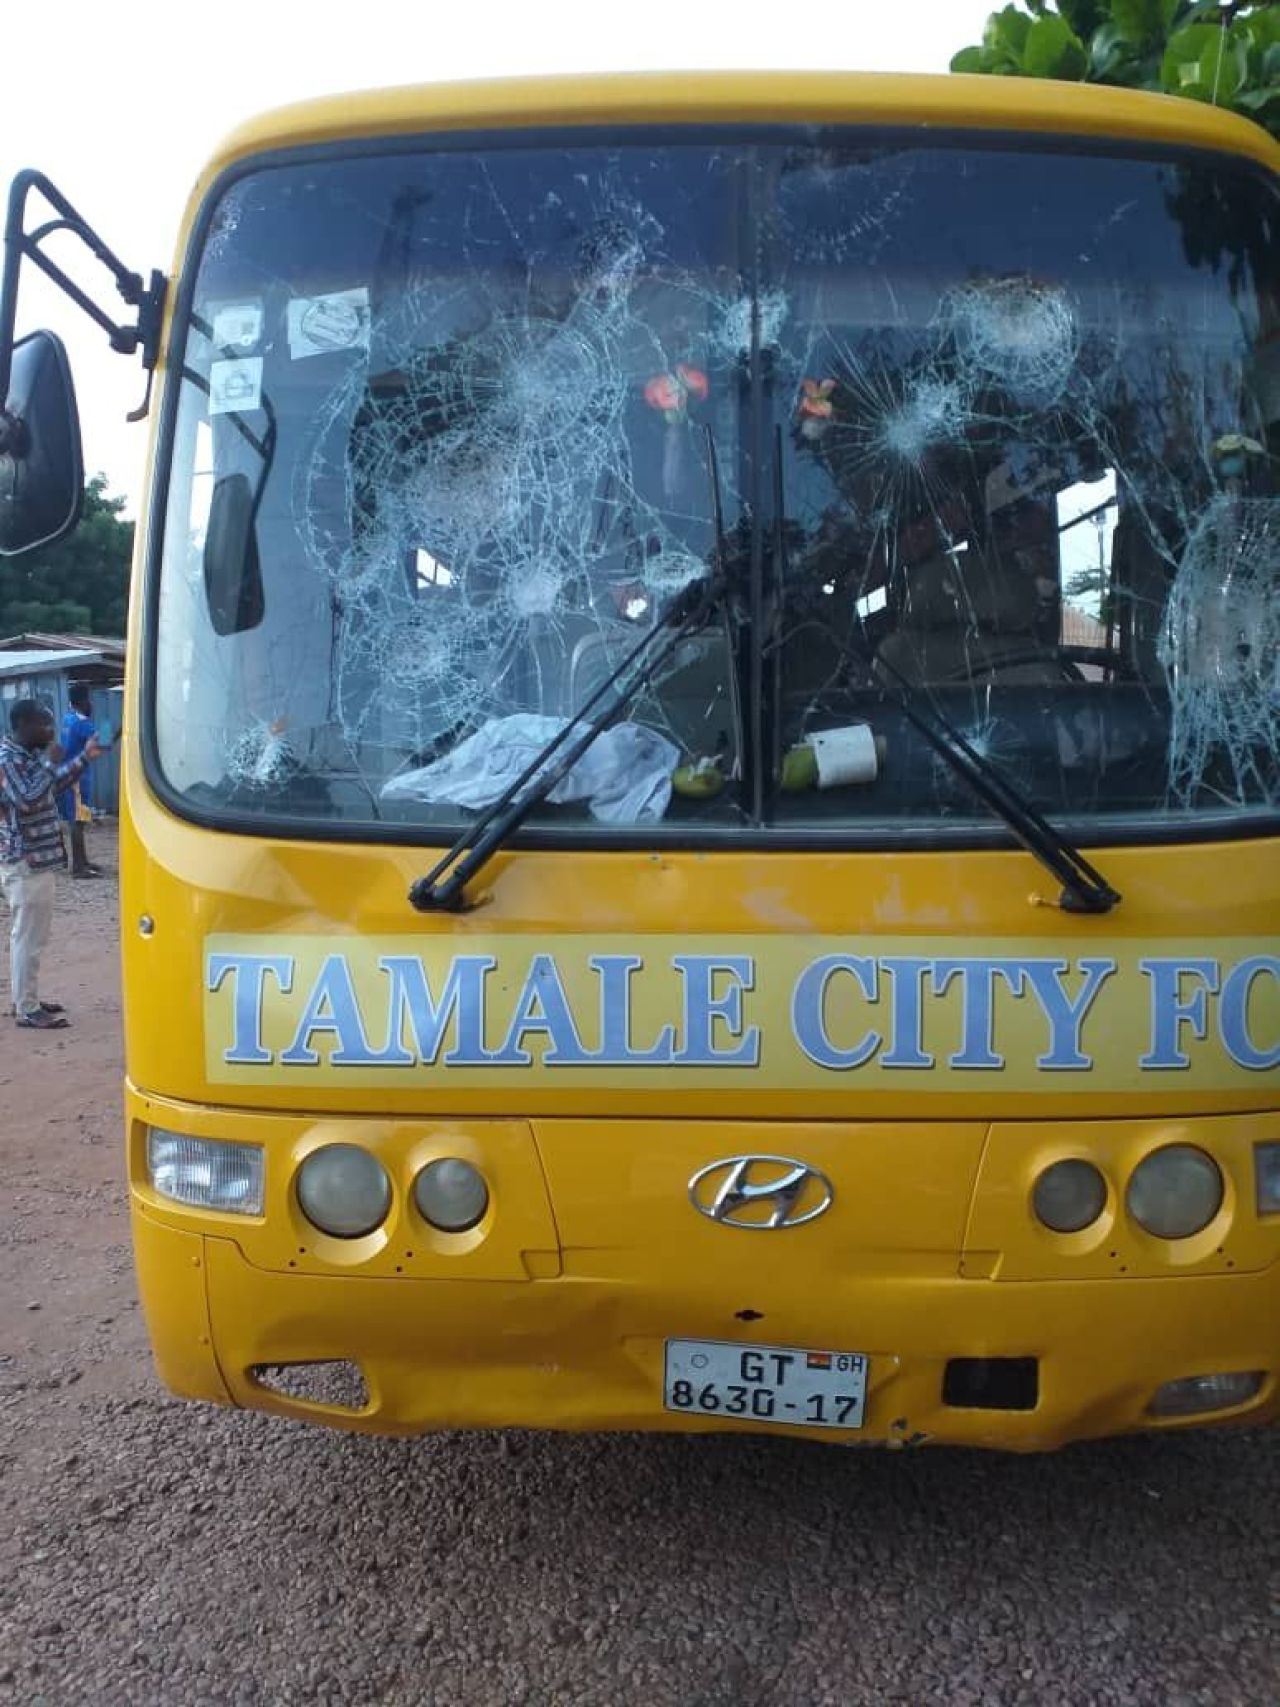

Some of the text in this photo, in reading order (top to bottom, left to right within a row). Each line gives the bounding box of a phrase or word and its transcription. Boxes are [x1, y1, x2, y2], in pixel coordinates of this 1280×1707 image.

[207, 953, 1280, 1070] TAMALE CITY FC
[740, 1351, 863, 1386] GT GH
